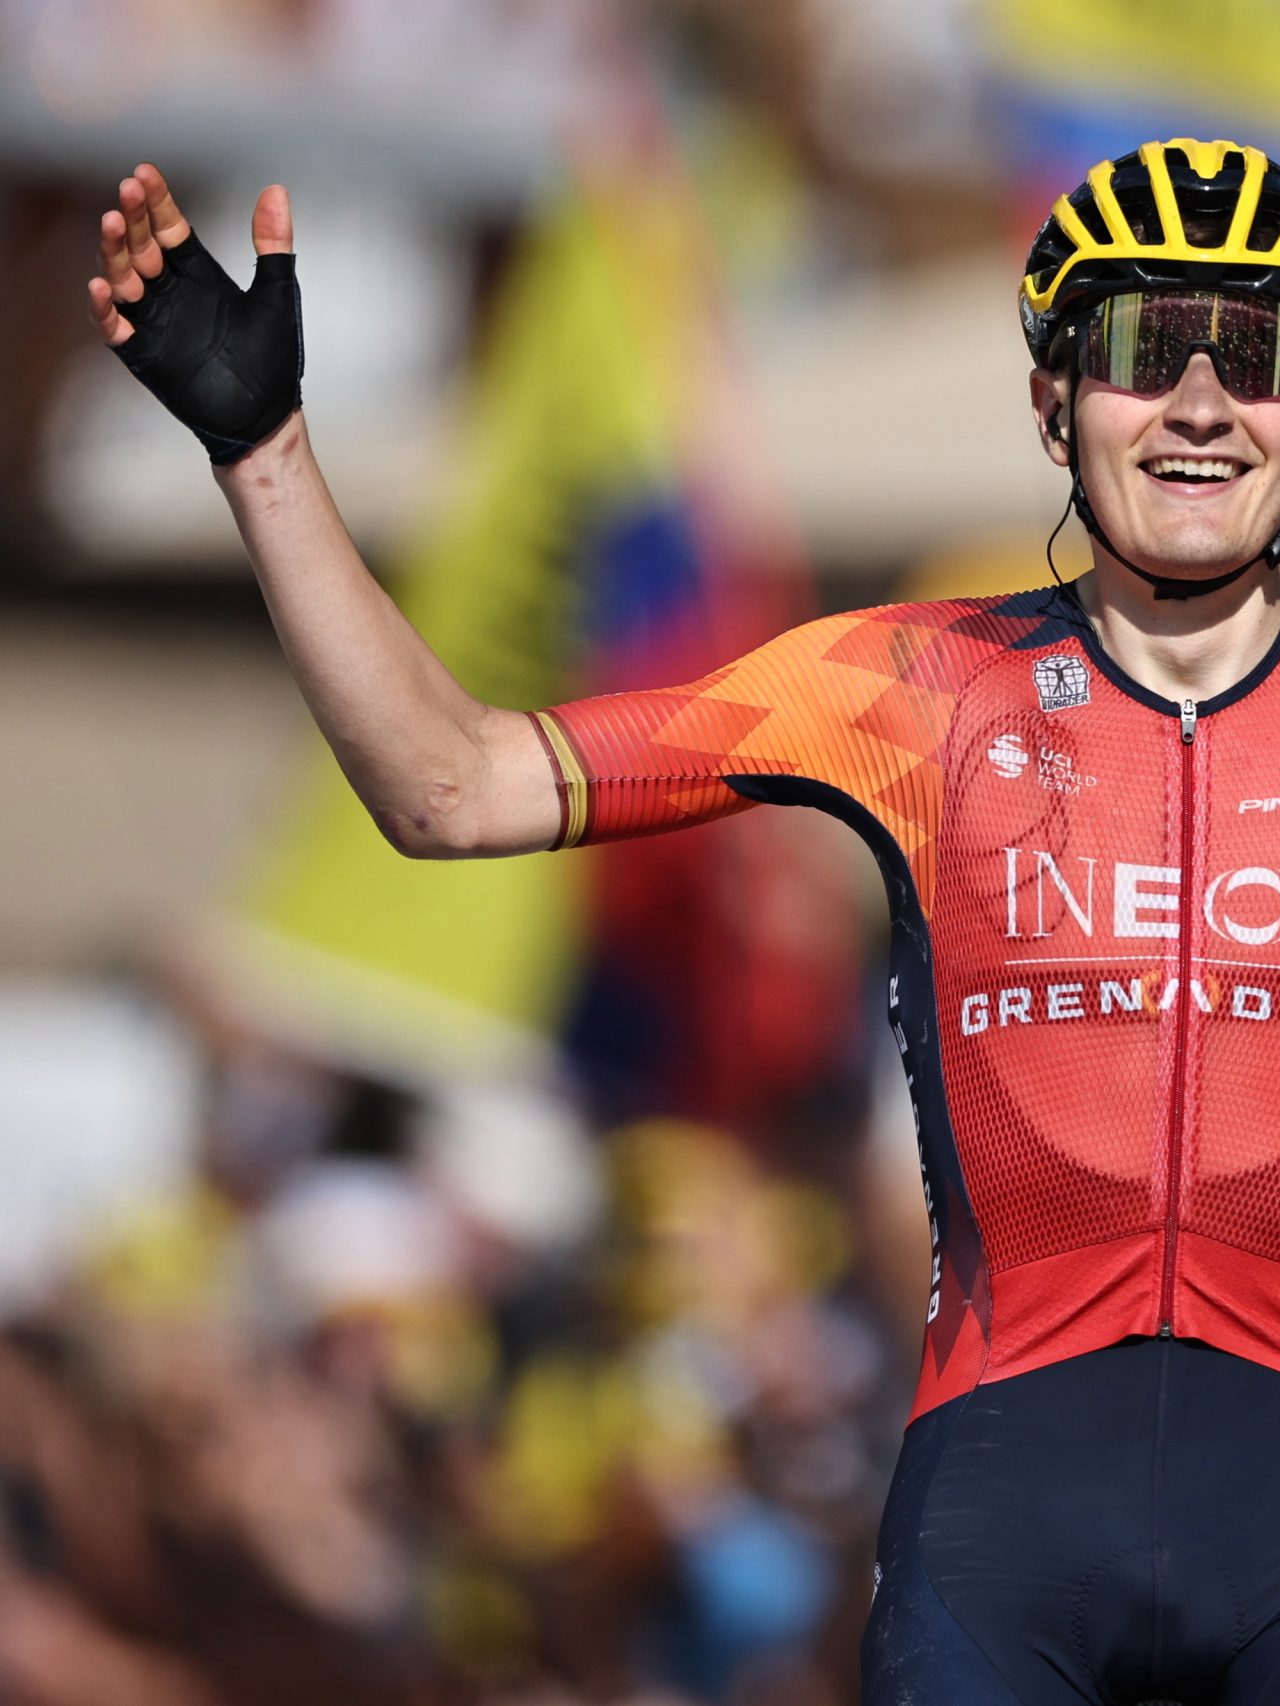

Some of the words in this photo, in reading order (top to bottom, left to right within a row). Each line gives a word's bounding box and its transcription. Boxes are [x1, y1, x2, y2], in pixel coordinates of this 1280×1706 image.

[1040, 746, 1072, 769] UCI
[1038, 760, 1097, 787] WORLD
[1037, 774, 1081, 798] TEAM
